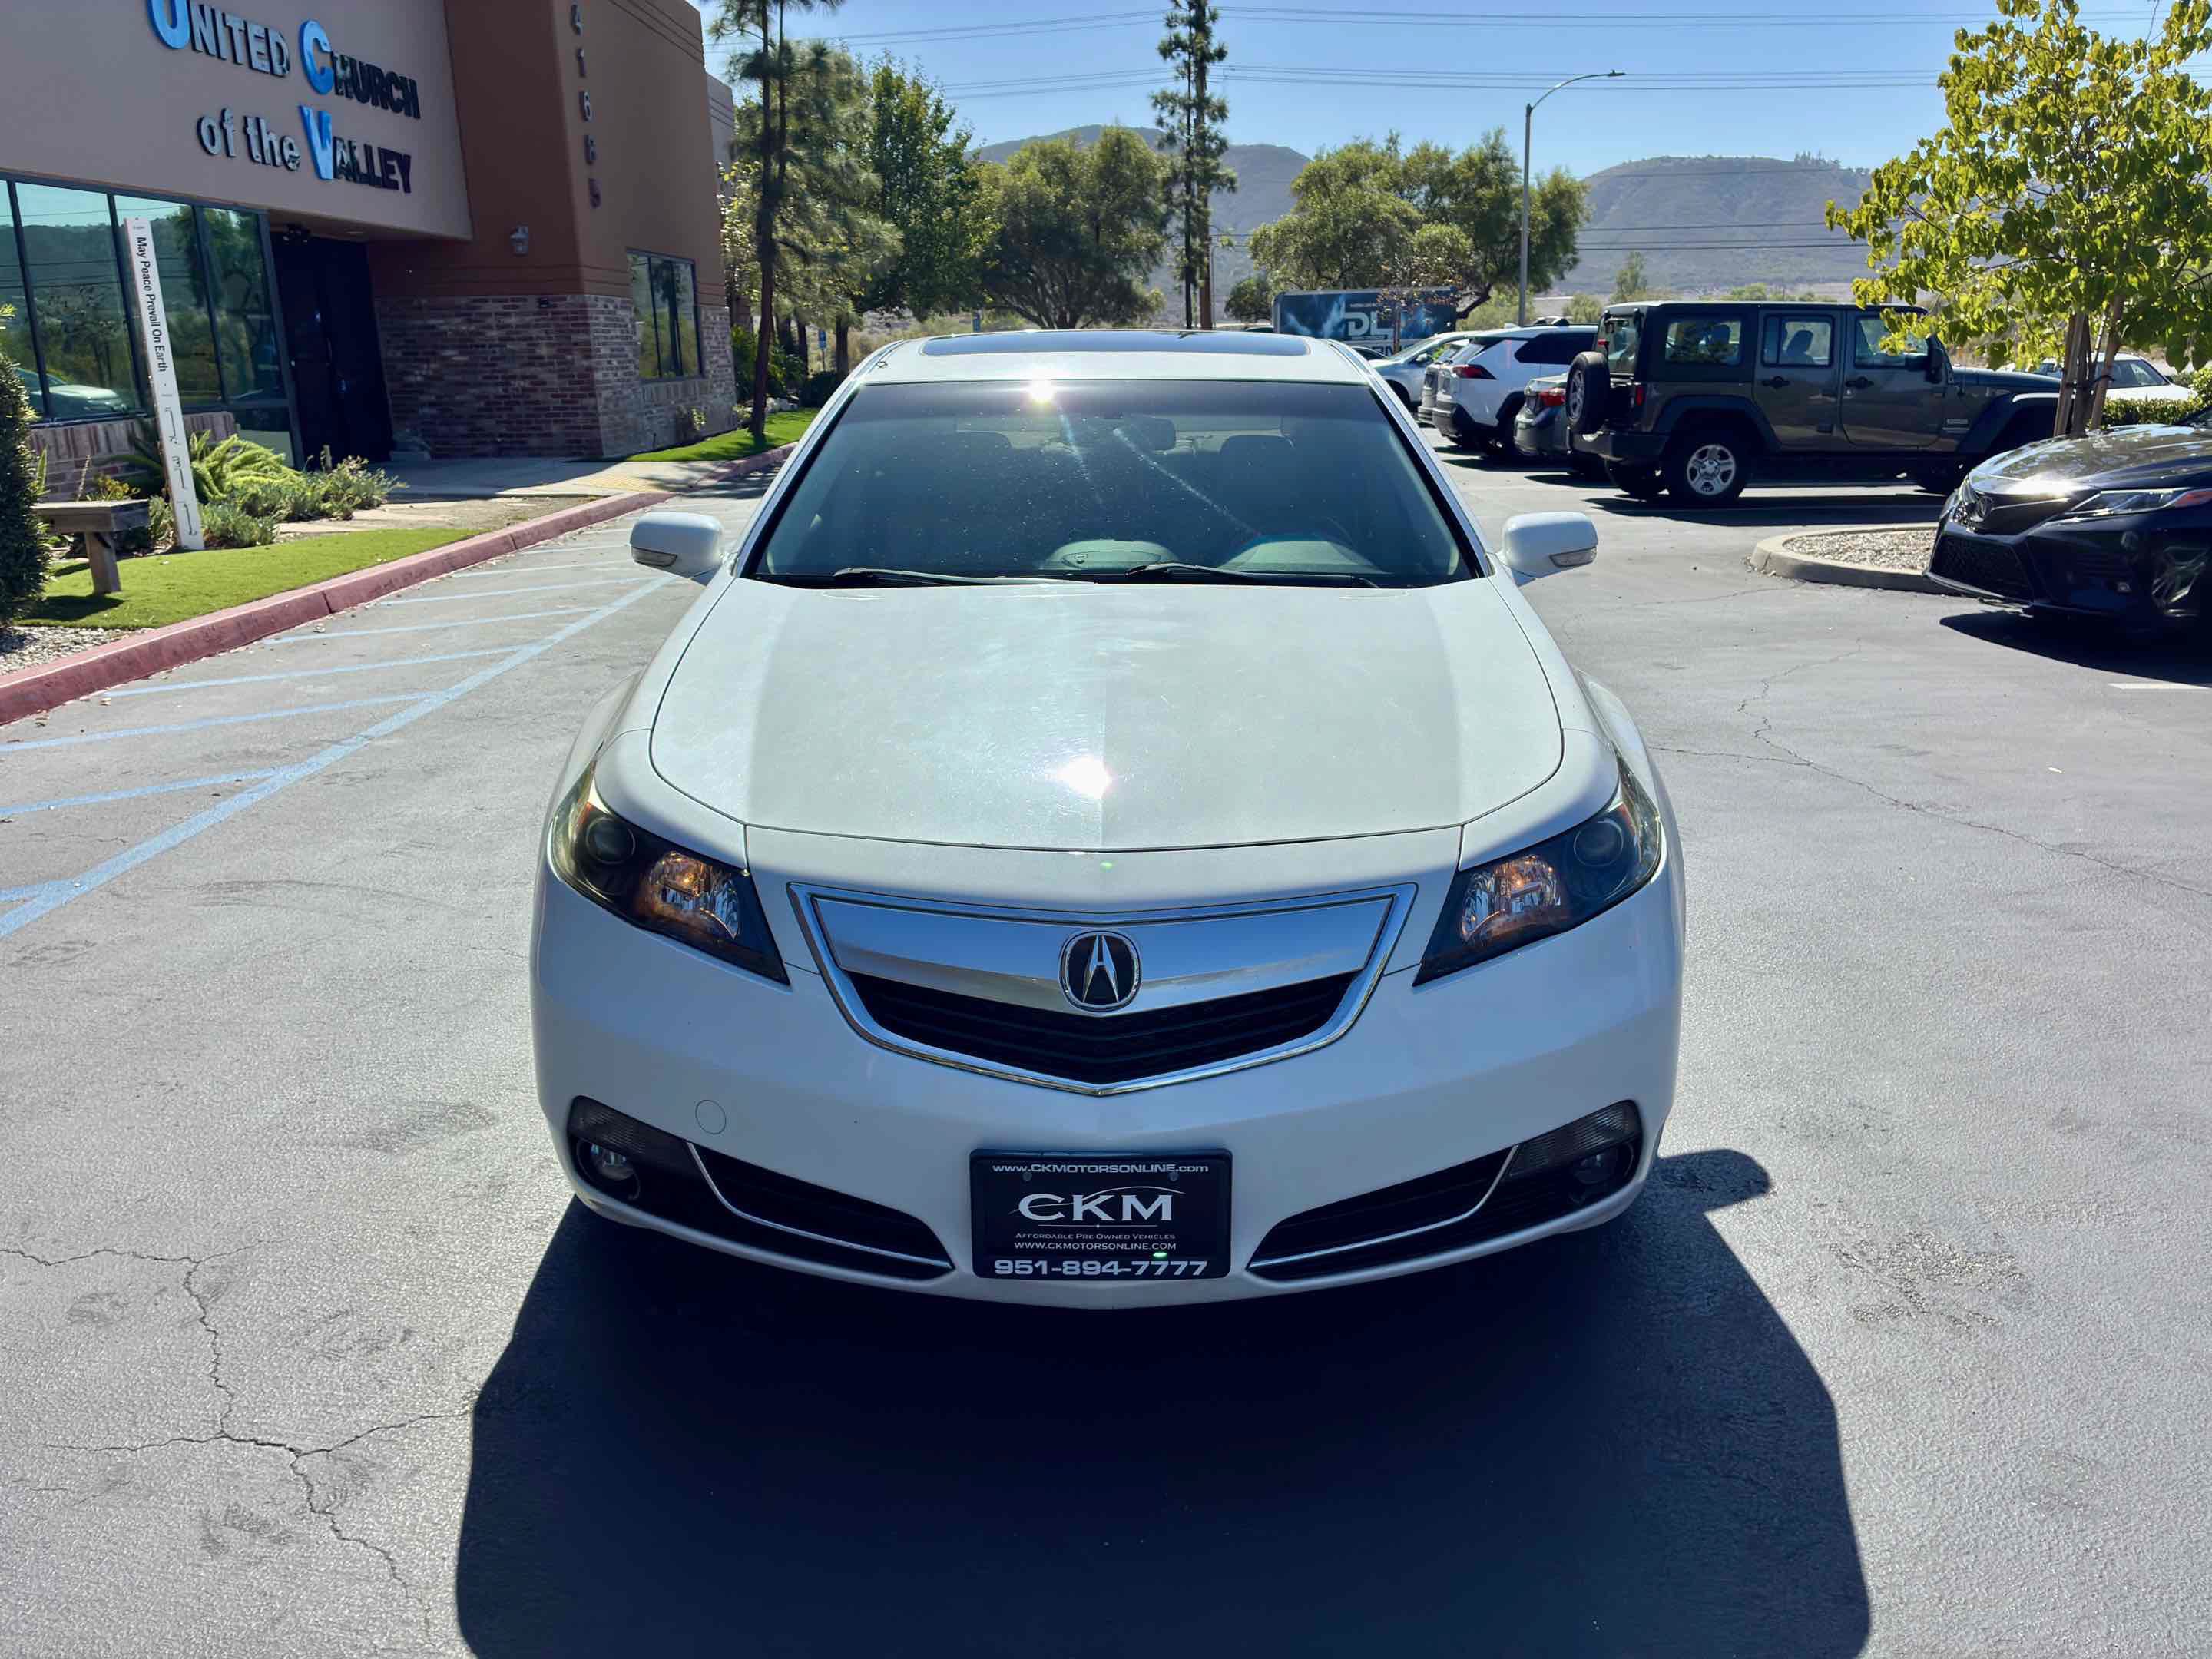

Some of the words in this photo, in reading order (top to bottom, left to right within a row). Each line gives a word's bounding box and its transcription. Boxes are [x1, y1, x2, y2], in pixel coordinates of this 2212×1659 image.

[298, 19, 421, 119] CHURCH
[197, 107, 237, 158] of
[243, 115, 300, 171] the
[297, 104, 412, 193] VALLEY
[135, 237, 147, 258] May
[141, 260, 152, 292] Peace
[146, 293, 161, 328] Prevail
[152, 329, 162, 343] On
[154, 345, 168, 373] Earth
[992, 1164, 1209, 1174] www.CKMOTORSONLINE.com
[1018, 1193, 1173, 1221] CKM
[1014, 1242, 1177, 1250] WWW.CKMOTORSONLINE.COM
[995, 1260, 1208, 1277] 951-894-7777
